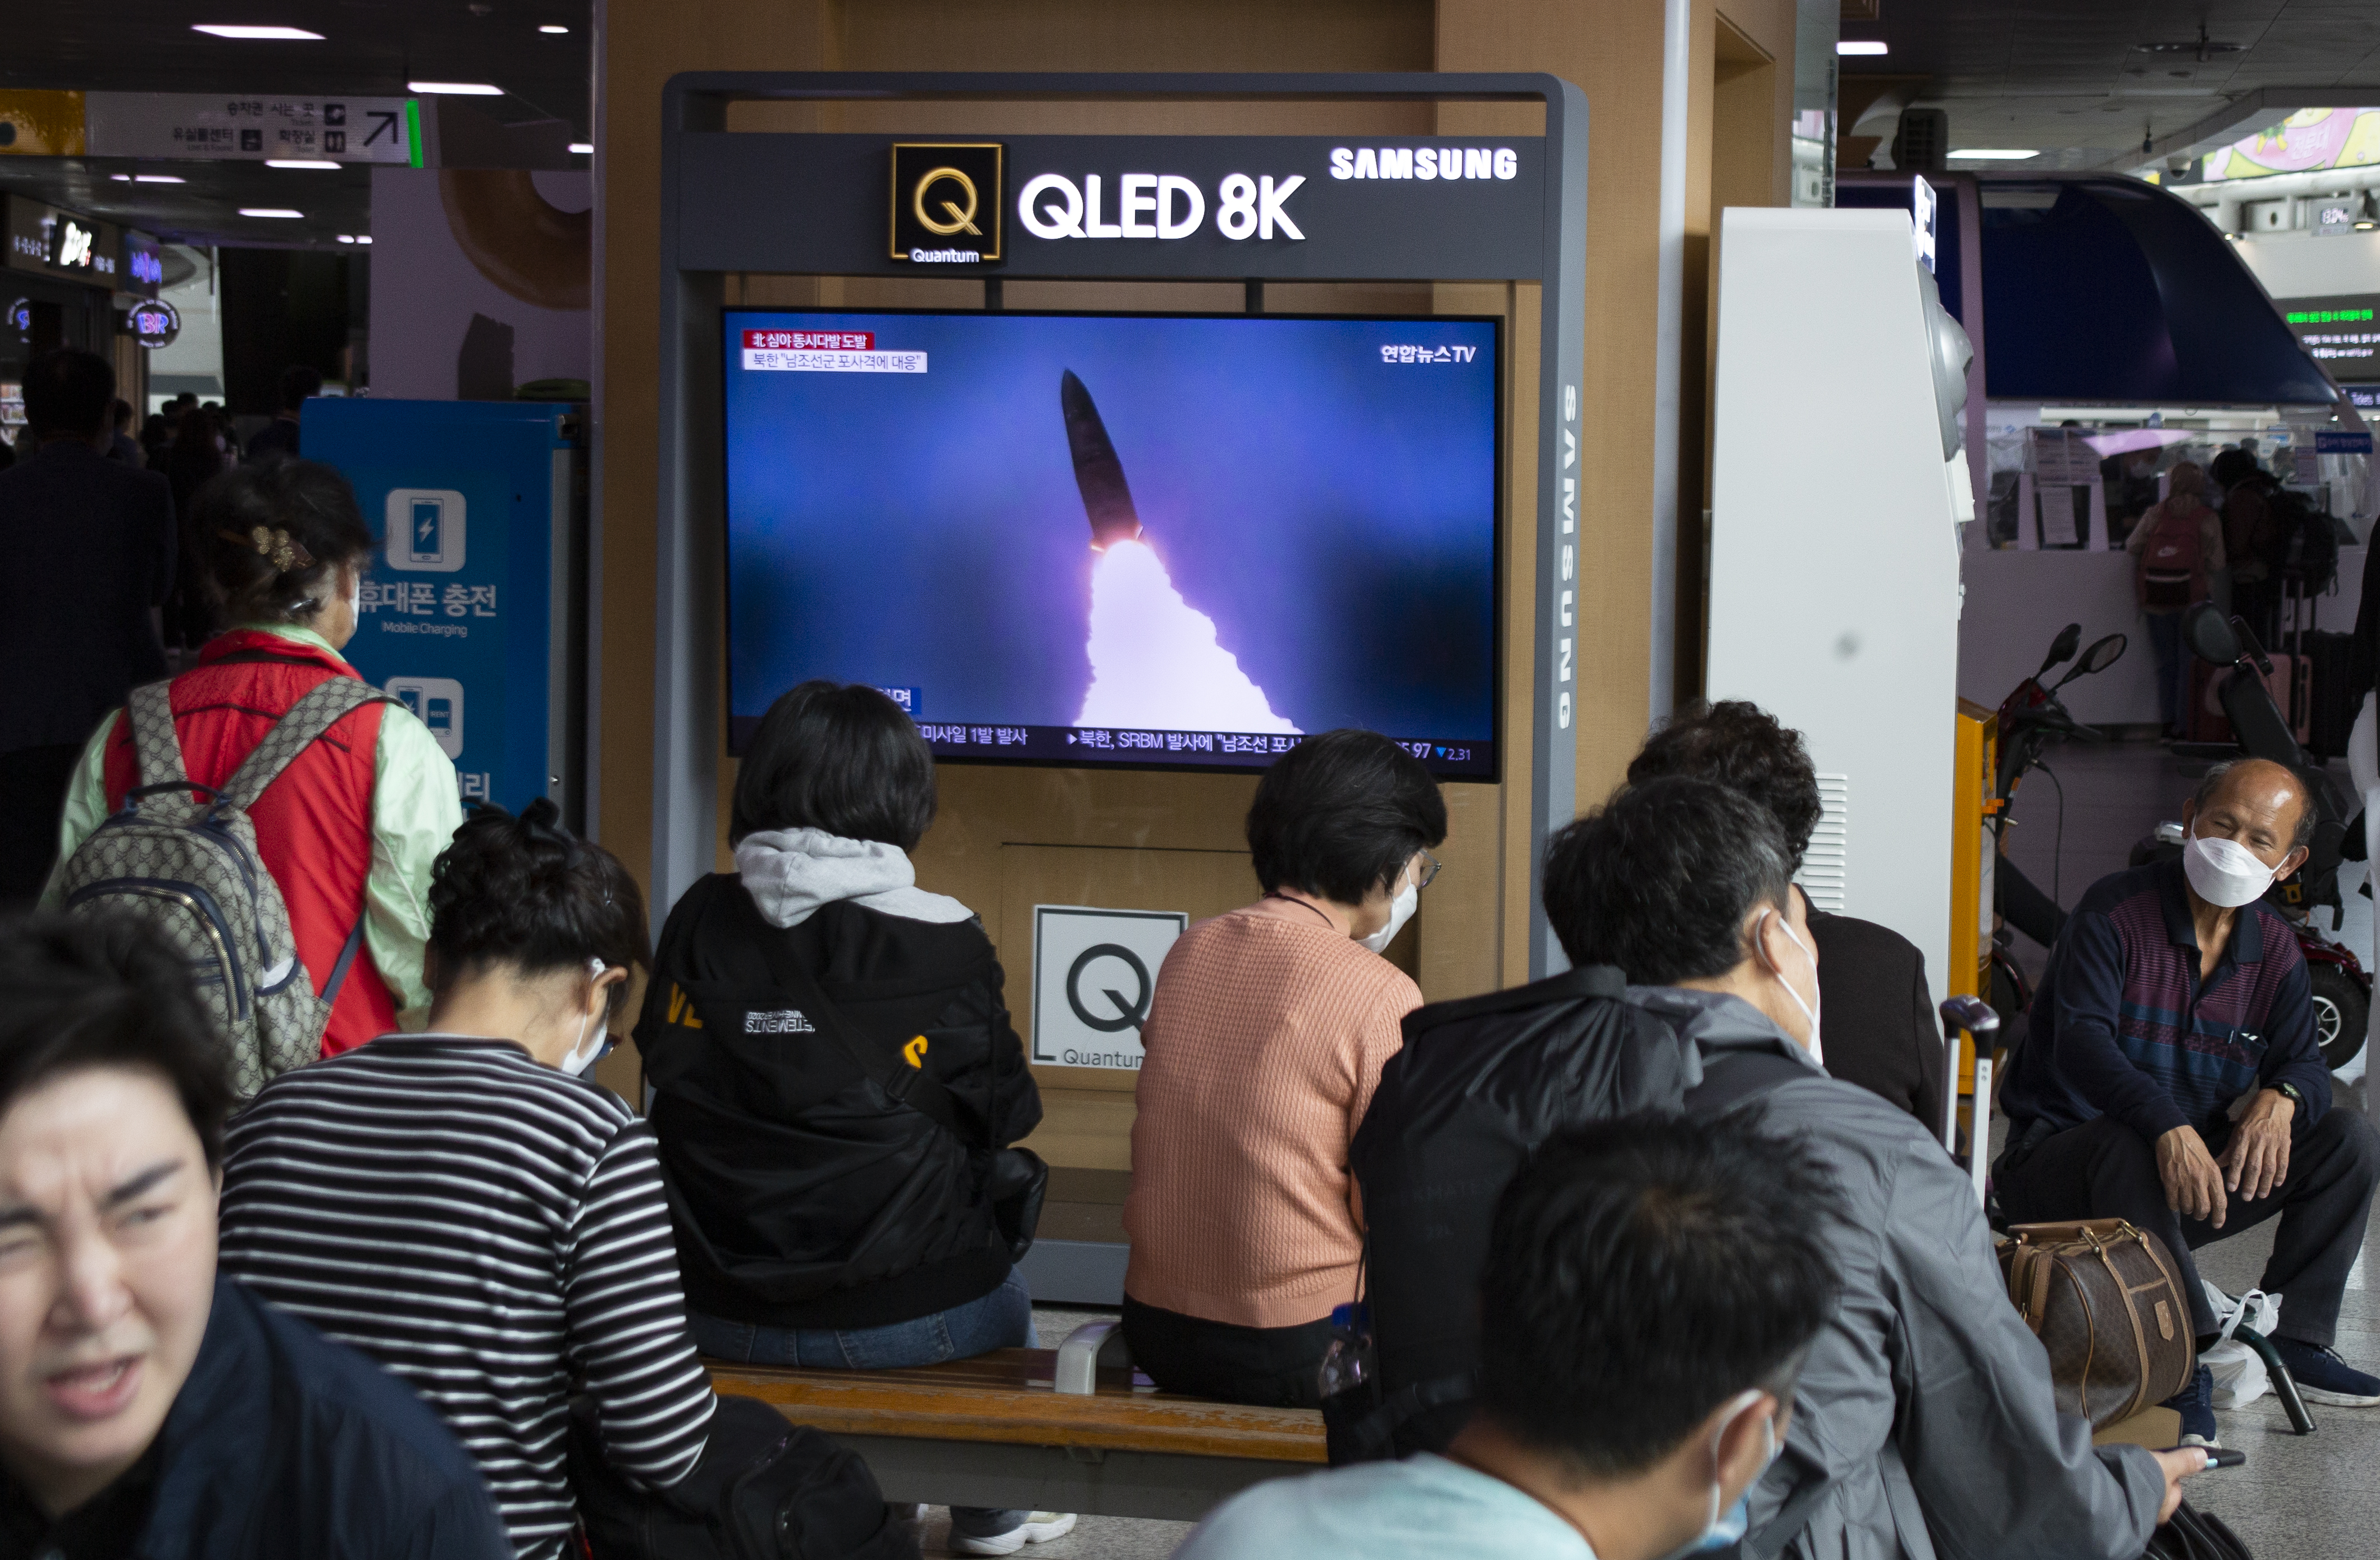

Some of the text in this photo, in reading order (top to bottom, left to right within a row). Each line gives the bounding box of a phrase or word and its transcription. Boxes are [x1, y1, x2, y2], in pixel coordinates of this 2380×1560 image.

[1330, 147, 1517, 180] SAMSUNG
[915, 167, 983, 236] Q
[1018, 173, 1306, 240] QLED 8K
[909, 248, 979, 263] Quantum
[752, 333, 867, 349] 北 심야 동시다발 도발
[838, 355, 888, 370] 포사격에
[892, 355, 921, 371] 대응"
[1381, 345, 1476, 363] 연합뉴스TV
[1560, 385, 1576, 729] SAMSUNG
[360, 581, 496, 617] 휴대폰 충전
[382, 621, 468, 637] Mobile Charging
[886, 688, 911, 711] 면
[918, 726, 966, 743] 미사일
[969, 727, 993, 745] 1발
[996, 727, 1028, 745] 발사
[1119, 732, 1164, 749] SRBM
[1168, 733, 1213, 751] 발사에
[1447, 749, 1470, 761] 2.31
[457, 772, 490, 802] 리
[1067, 943, 1151, 1032] Q
[745, 1019, 815, 1033] ETEMENTS
